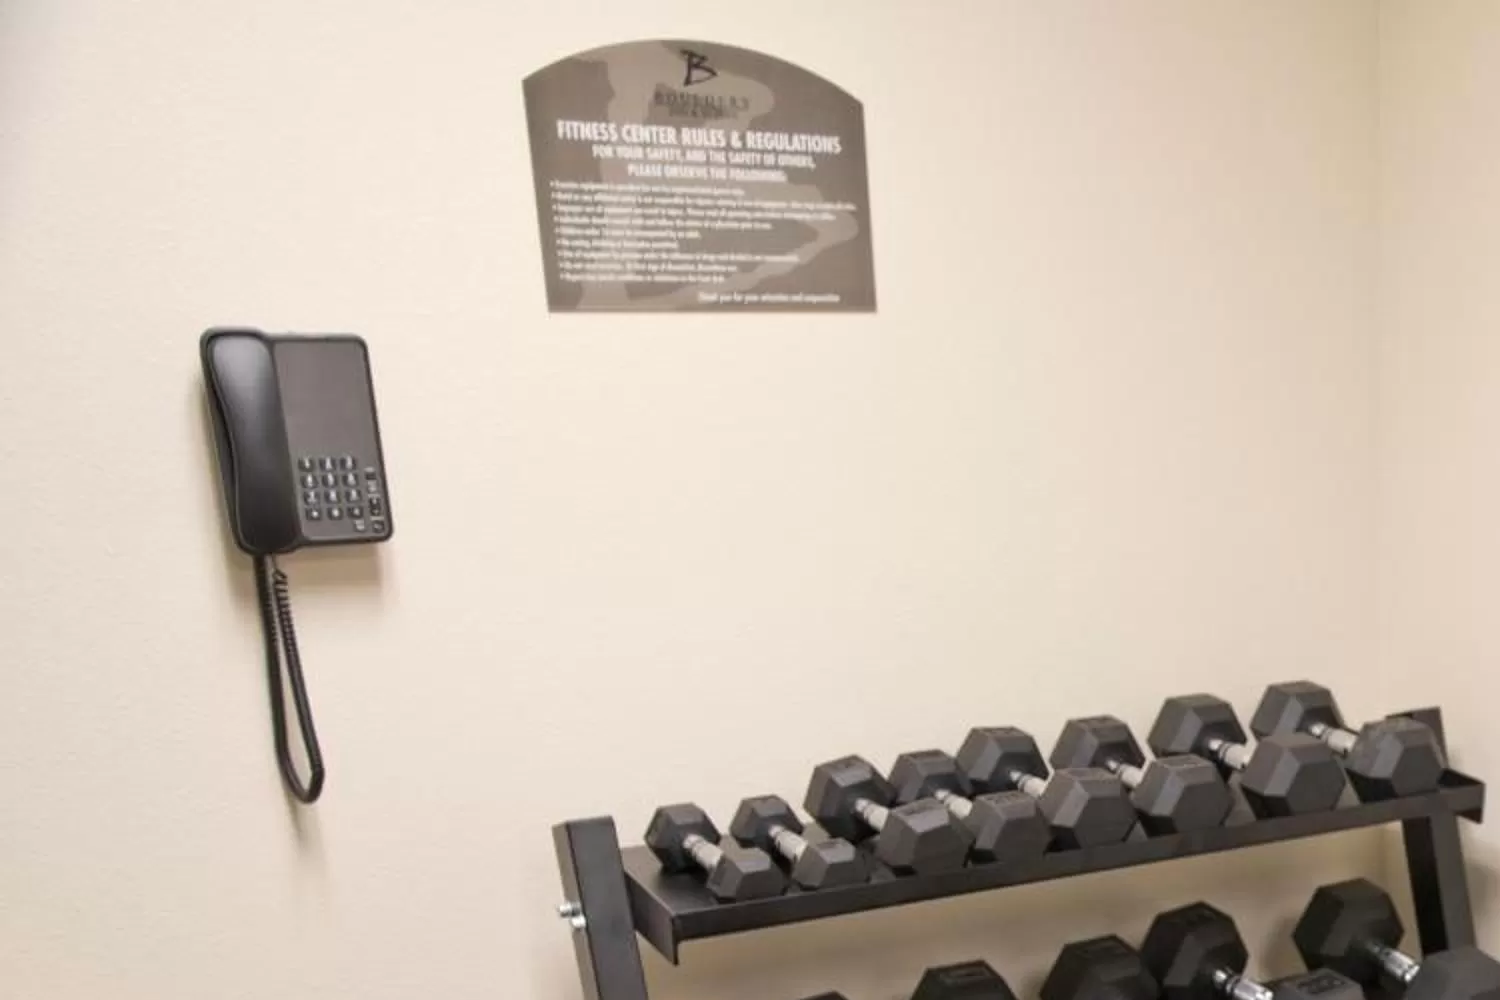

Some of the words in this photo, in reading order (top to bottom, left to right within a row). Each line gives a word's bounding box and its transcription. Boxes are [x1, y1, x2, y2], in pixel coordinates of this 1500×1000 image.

[556, 119, 618, 142] FITNESS
[621, 124, 679, 145] CENTER
[682, 127, 726, 149] RULES
[730, 130, 743, 150] &
[745, 131, 842, 154] REGULATIONS
[592, 144, 614, 158] FOR
[709, 150, 726, 163] THE
[728, 151, 761, 165] SAFETY
[763, 153, 776, 166] OF
[627, 163, 661, 177] PLEASE
[709, 167, 727, 180] THE
